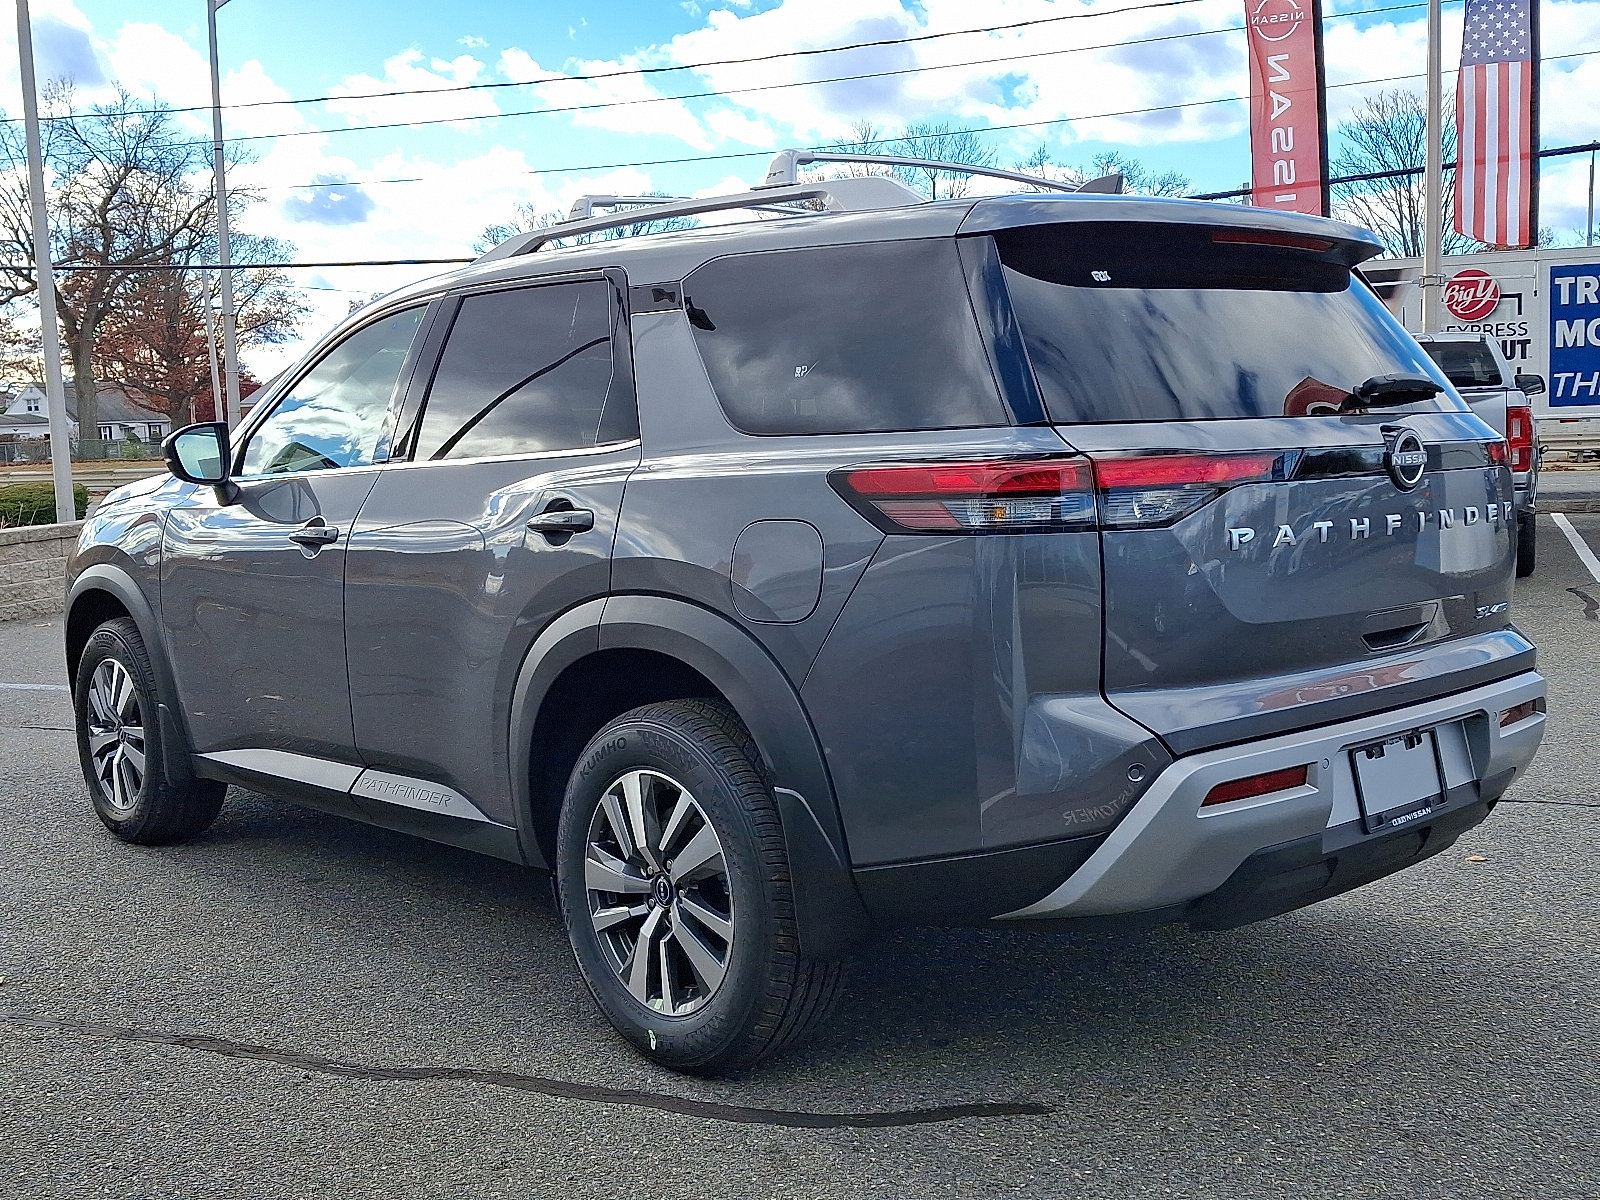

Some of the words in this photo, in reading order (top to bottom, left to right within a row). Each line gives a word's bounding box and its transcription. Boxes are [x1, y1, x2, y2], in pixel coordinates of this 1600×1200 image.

[1444, 282, 1475, 310] Big
[1554, 273, 1600, 305] TR
[1553, 371, 1600, 398] TH
[1392, 453, 1427, 465] NISSAN
[1228, 501, 1513, 551] PATHFINDER
[580, 736, 628, 779] KUMHO
[358, 777, 453, 807] PATHFINDER
